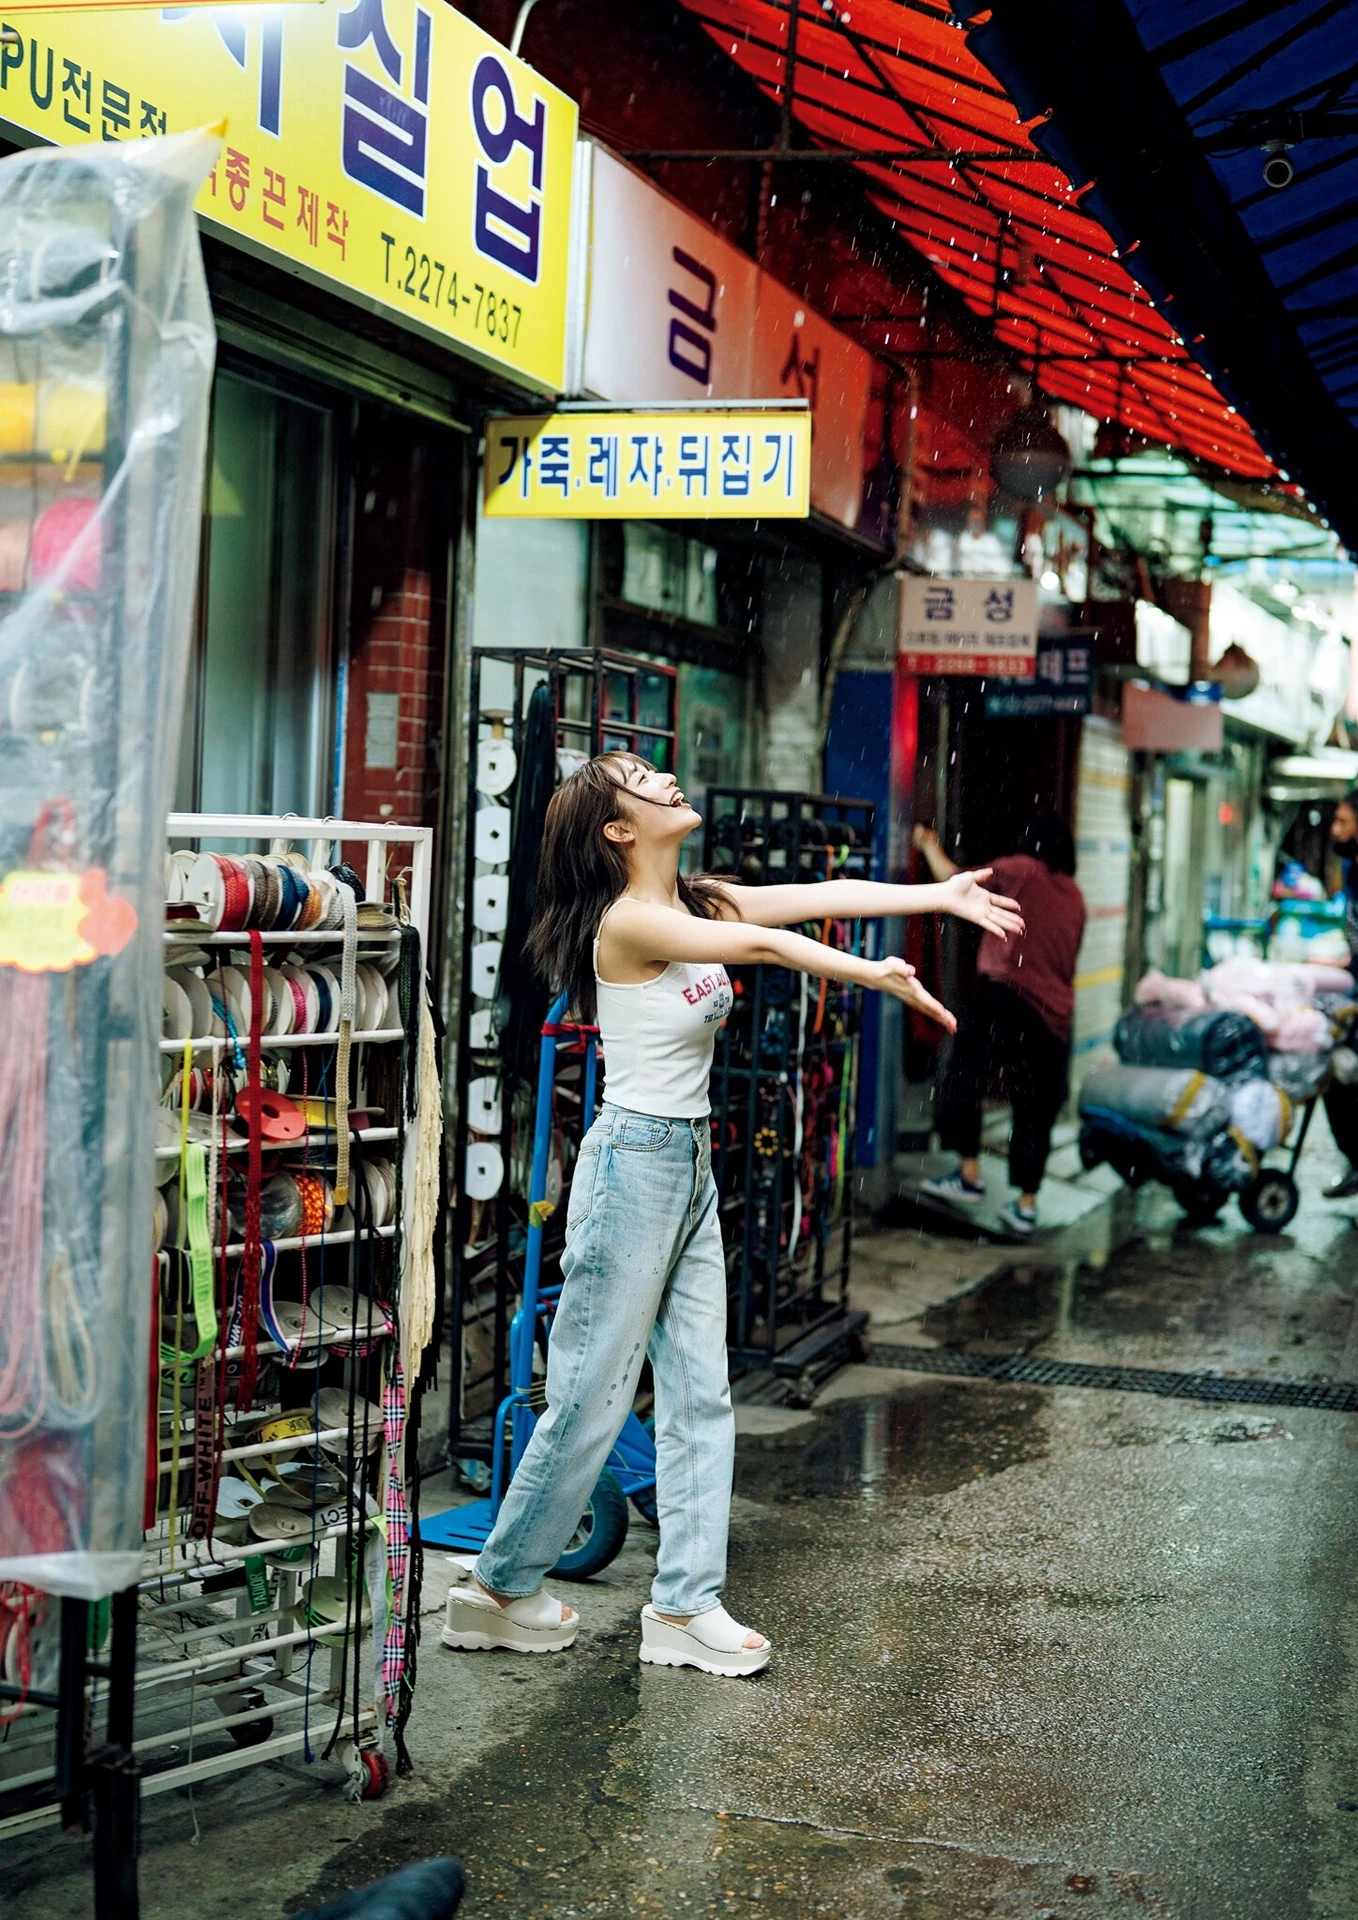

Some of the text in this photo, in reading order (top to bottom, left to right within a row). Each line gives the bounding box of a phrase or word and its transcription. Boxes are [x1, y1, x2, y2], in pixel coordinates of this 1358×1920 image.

[380, 231, 522, 349] T.2274-7837
[681, 974, 716, 1006] EAST
[191, 1396, 213, 1539] OFF-WHITE
[249, 1571, 268, 1608] J'ADIOR
